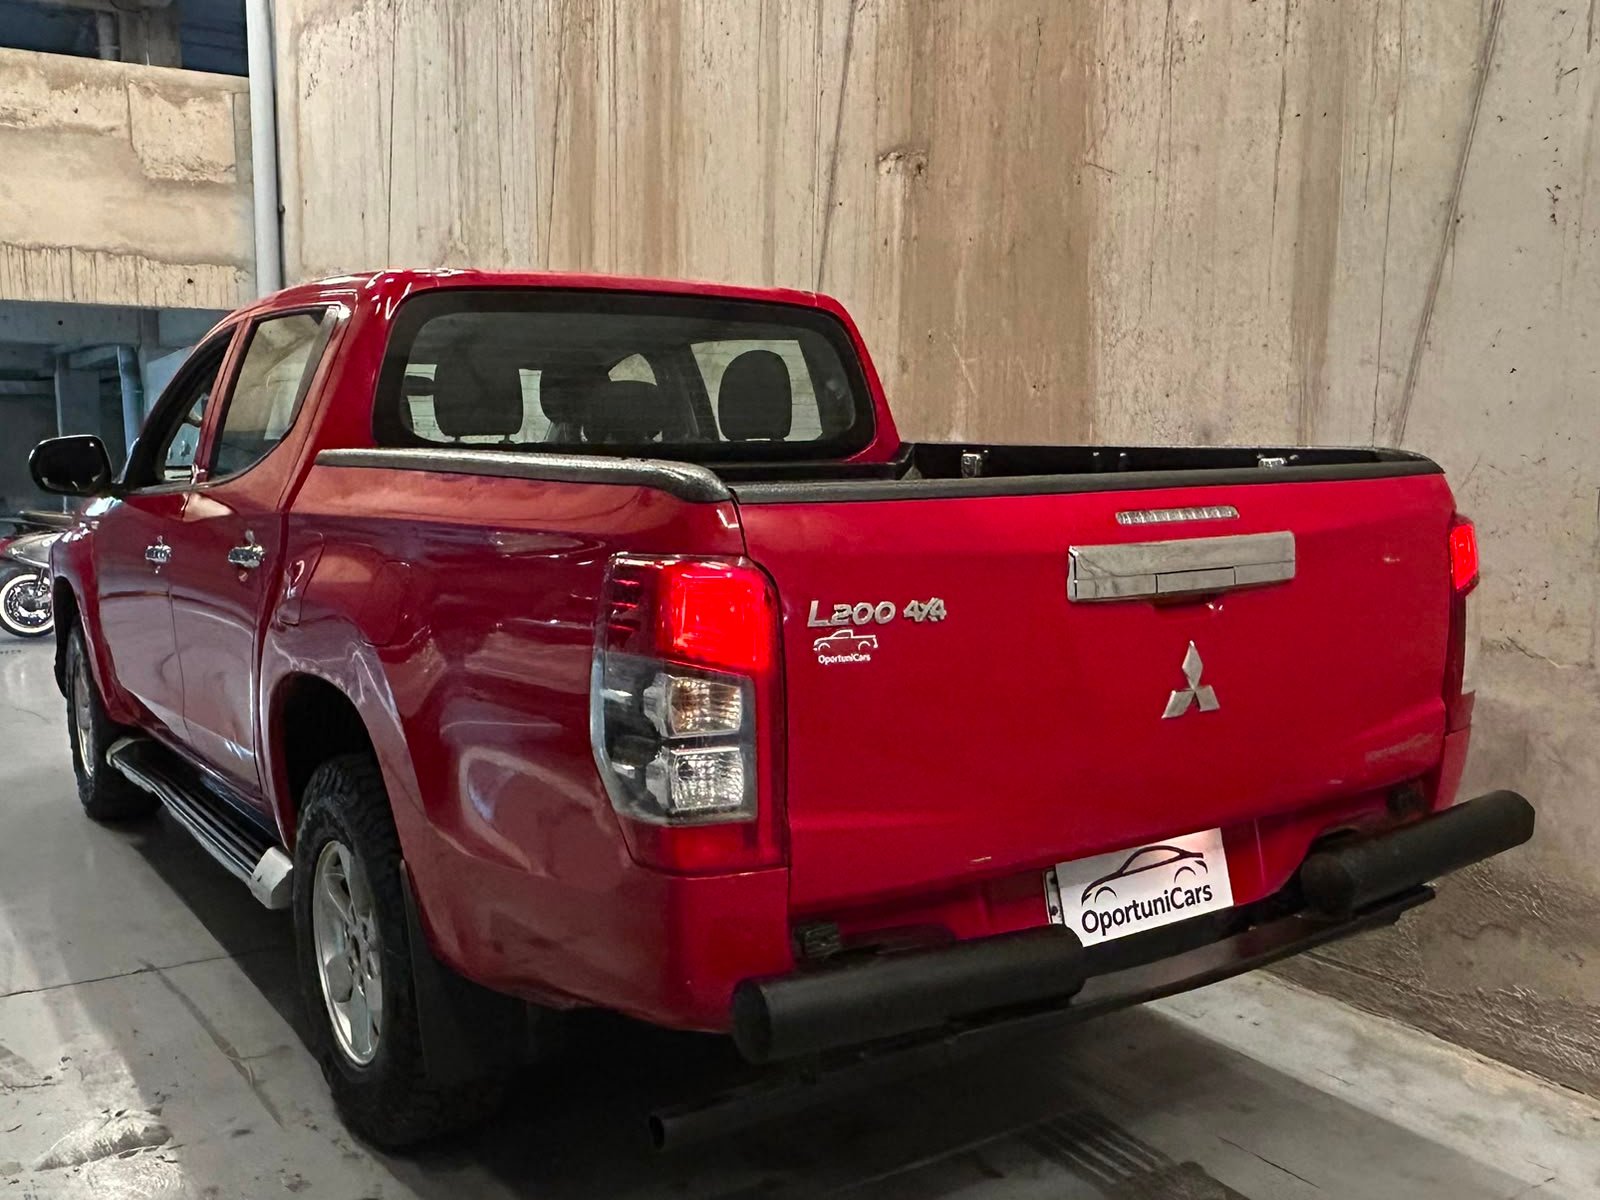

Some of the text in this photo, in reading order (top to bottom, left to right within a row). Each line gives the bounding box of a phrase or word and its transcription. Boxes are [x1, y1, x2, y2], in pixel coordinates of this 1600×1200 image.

[807, 600, 896, 627] L200
[818, 653, 871, 665] OportuniCars
[1081, 884, 1213, 936] OportuniCars
